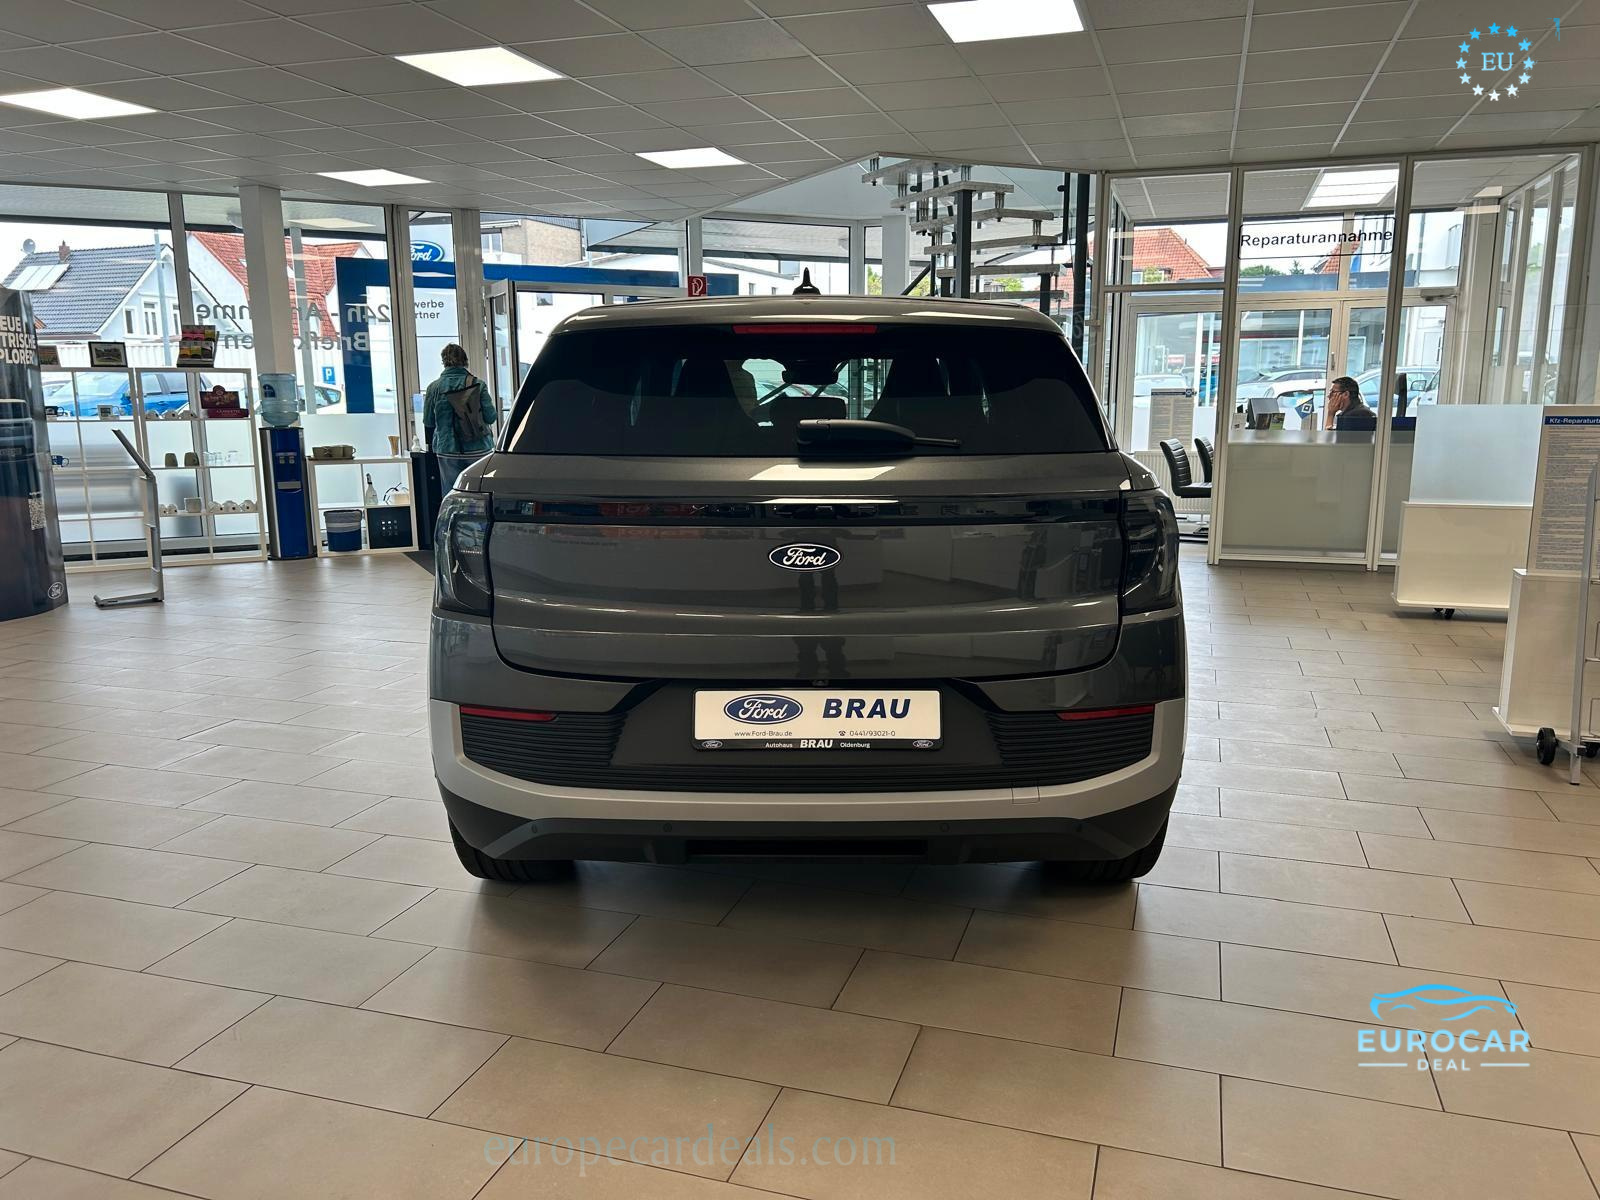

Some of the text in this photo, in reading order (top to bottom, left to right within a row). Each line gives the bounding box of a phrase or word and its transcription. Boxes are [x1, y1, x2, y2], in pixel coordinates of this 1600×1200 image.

[1241, 230, 1393, 249] Reparaturannahme
[783, 547, 827, 565] Ford
[738, 698, 911, 719] Ford BRAU
[800, 739, 834, 748] BRAU
